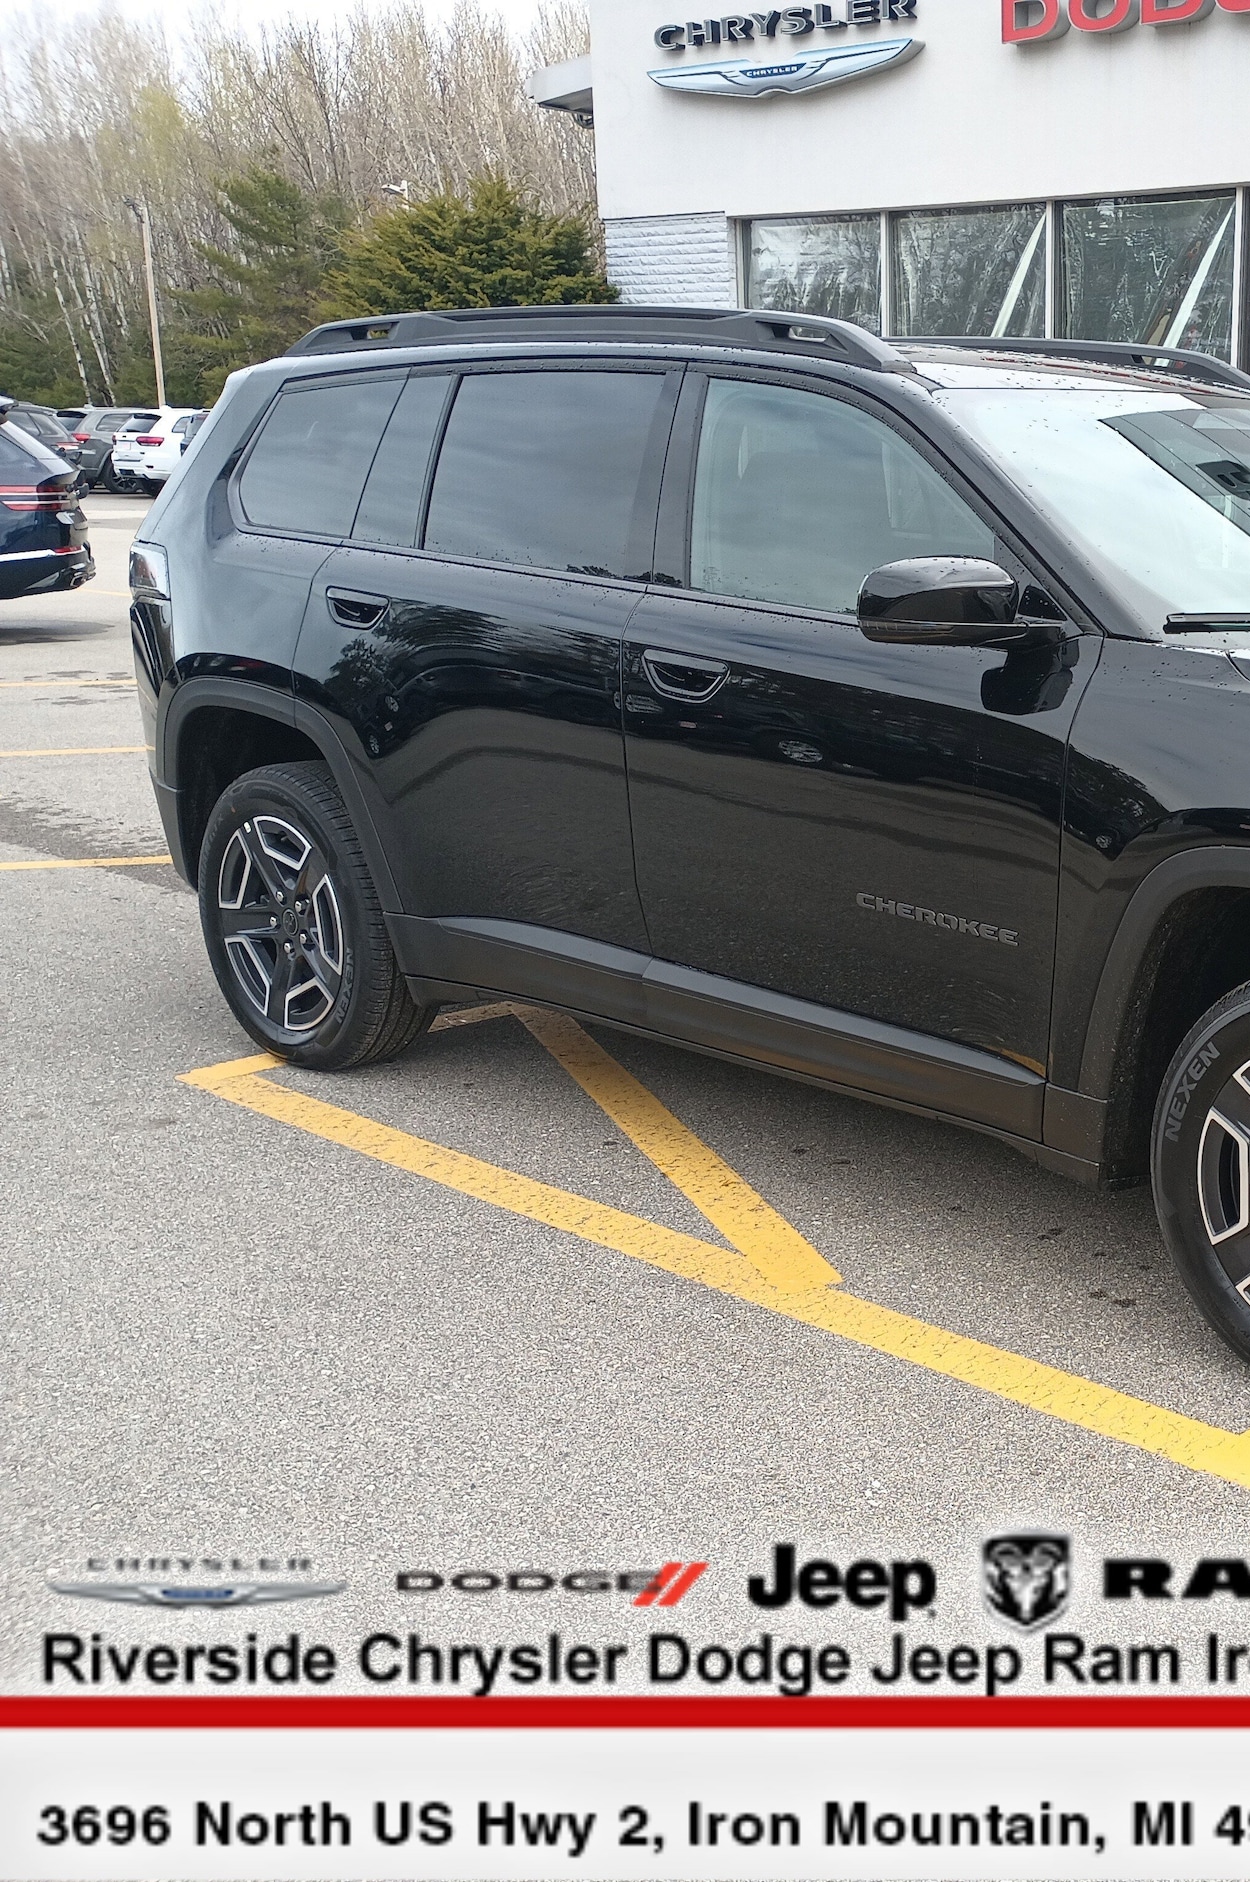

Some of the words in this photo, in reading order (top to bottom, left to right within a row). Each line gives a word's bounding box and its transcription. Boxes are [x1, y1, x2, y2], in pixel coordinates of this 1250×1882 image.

[654, 0, 914, 50] CHRYSLER
[745, 65, 798, 77] CHRYSLER
[855, 891, 1019, 947] CHEROKEE
[335, 947, 354, 1025] NEXEN
[1164, 1040, 1221, 1142] NEXEN
